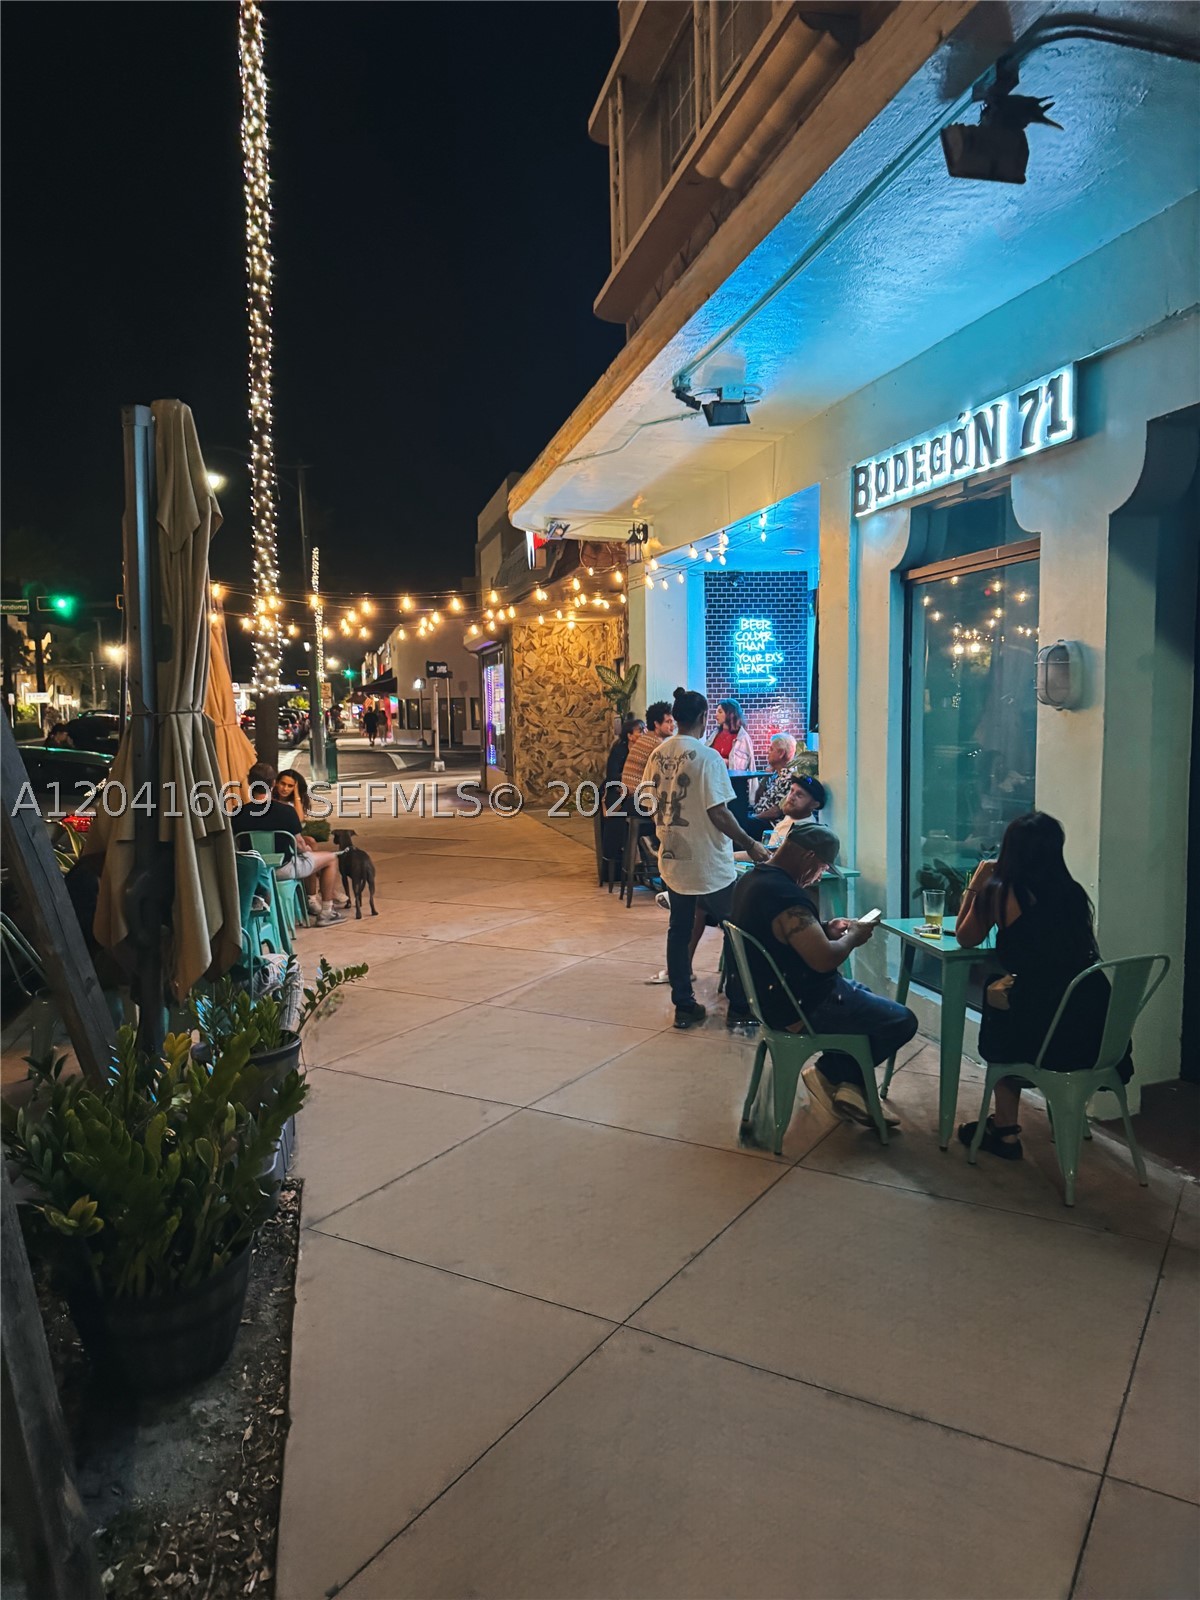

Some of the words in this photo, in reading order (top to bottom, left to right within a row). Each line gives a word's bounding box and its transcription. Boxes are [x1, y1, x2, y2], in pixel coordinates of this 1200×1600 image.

[854, 403, 1003, 514] BODEGÓN
[1018, 374, 1067, 450] 71
[740, 618, 771, 630] BEER
[735, 631, 775, 642] COLDER
[735, 641, 765, 651] THAN
[736, 652, 764, 662] YOUR
[737, 663, 772, 673] HEART
